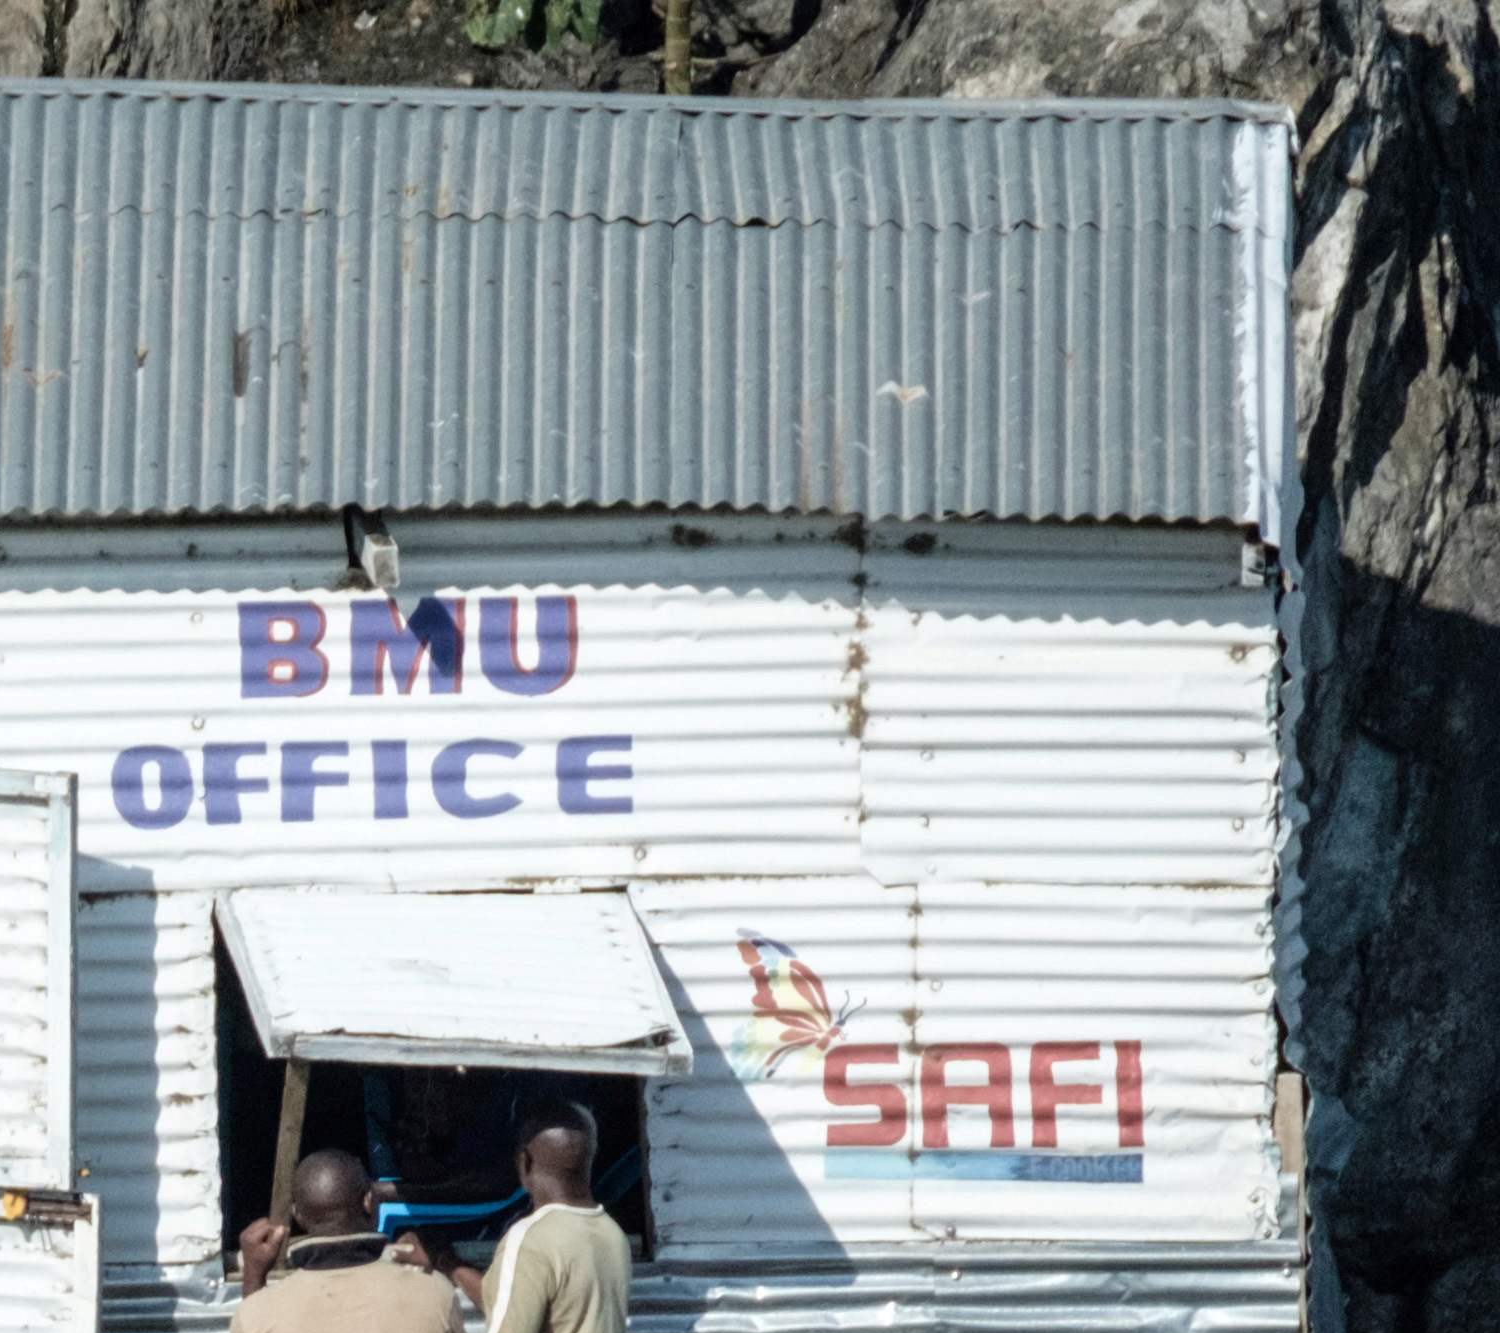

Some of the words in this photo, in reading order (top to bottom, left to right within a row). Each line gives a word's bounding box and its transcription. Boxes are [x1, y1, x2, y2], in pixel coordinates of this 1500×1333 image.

[237, 595, 578, 699] BMU
[111, 735, 634, 829] OFFICE
[823, 1040, 1145, 1148] SAFI
